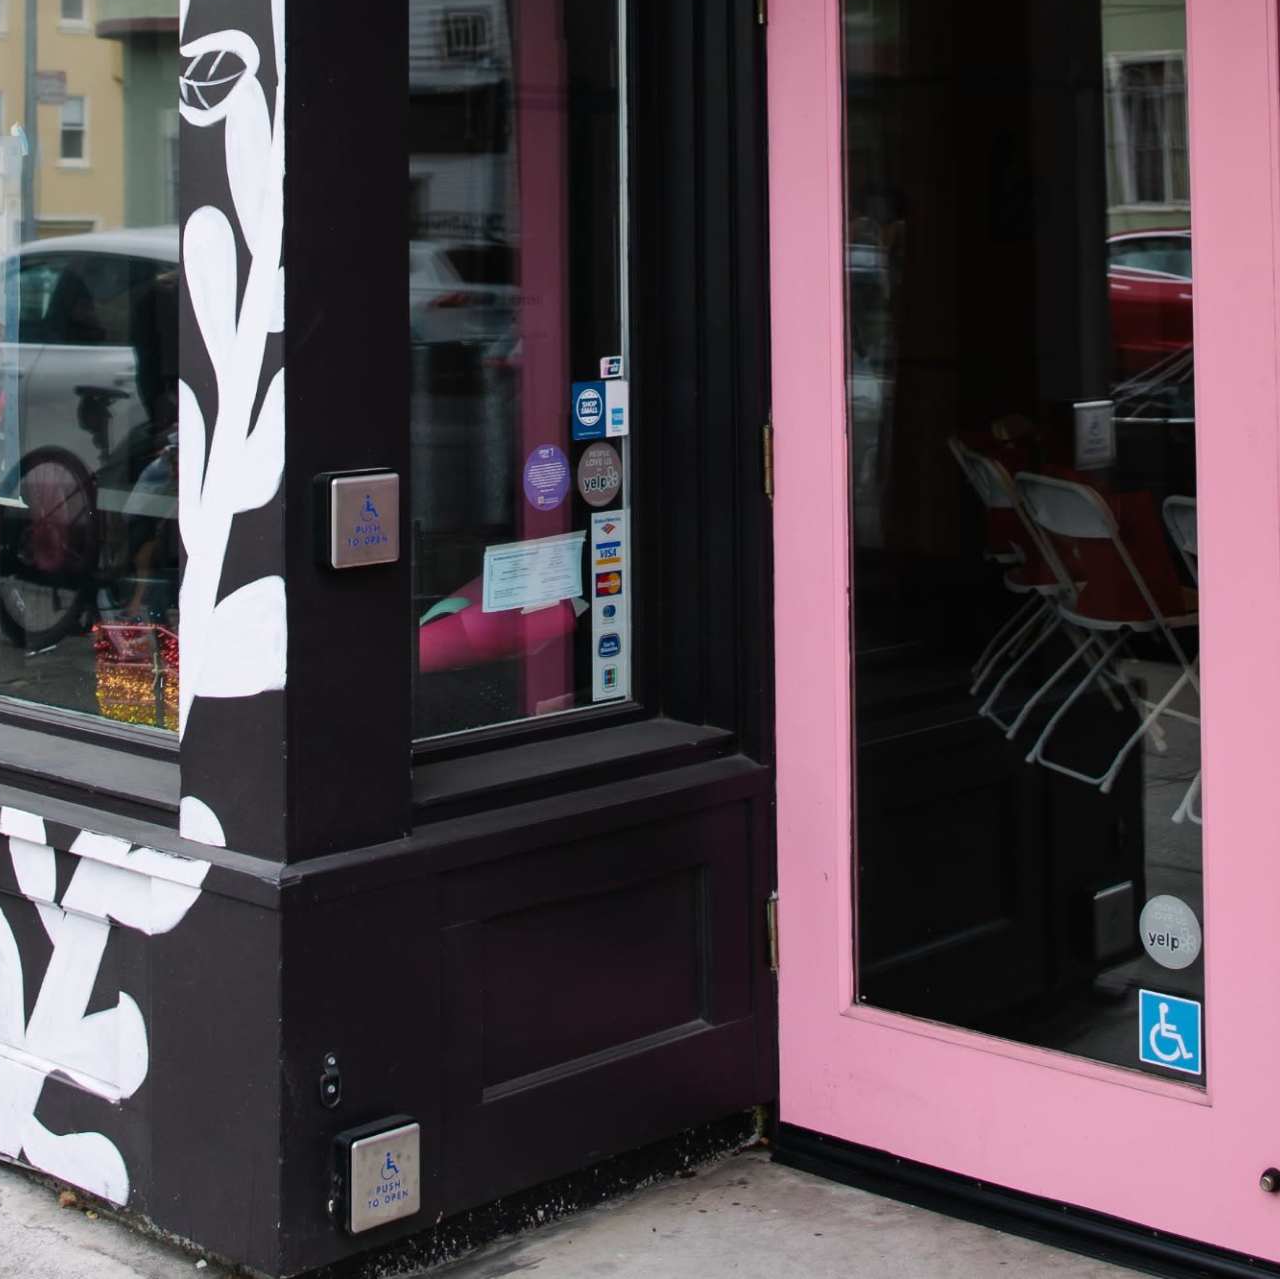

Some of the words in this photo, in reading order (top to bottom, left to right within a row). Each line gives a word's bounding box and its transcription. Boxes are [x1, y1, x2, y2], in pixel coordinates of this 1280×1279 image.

[584, 475, 607, 491] yelp
[599, 547, 617, 559] VISA
[1148, 931, 1180, 951] yelp
[376, 1181, 401, 1194] PUSH
[384, 1191, 408, 1204] OPEN
